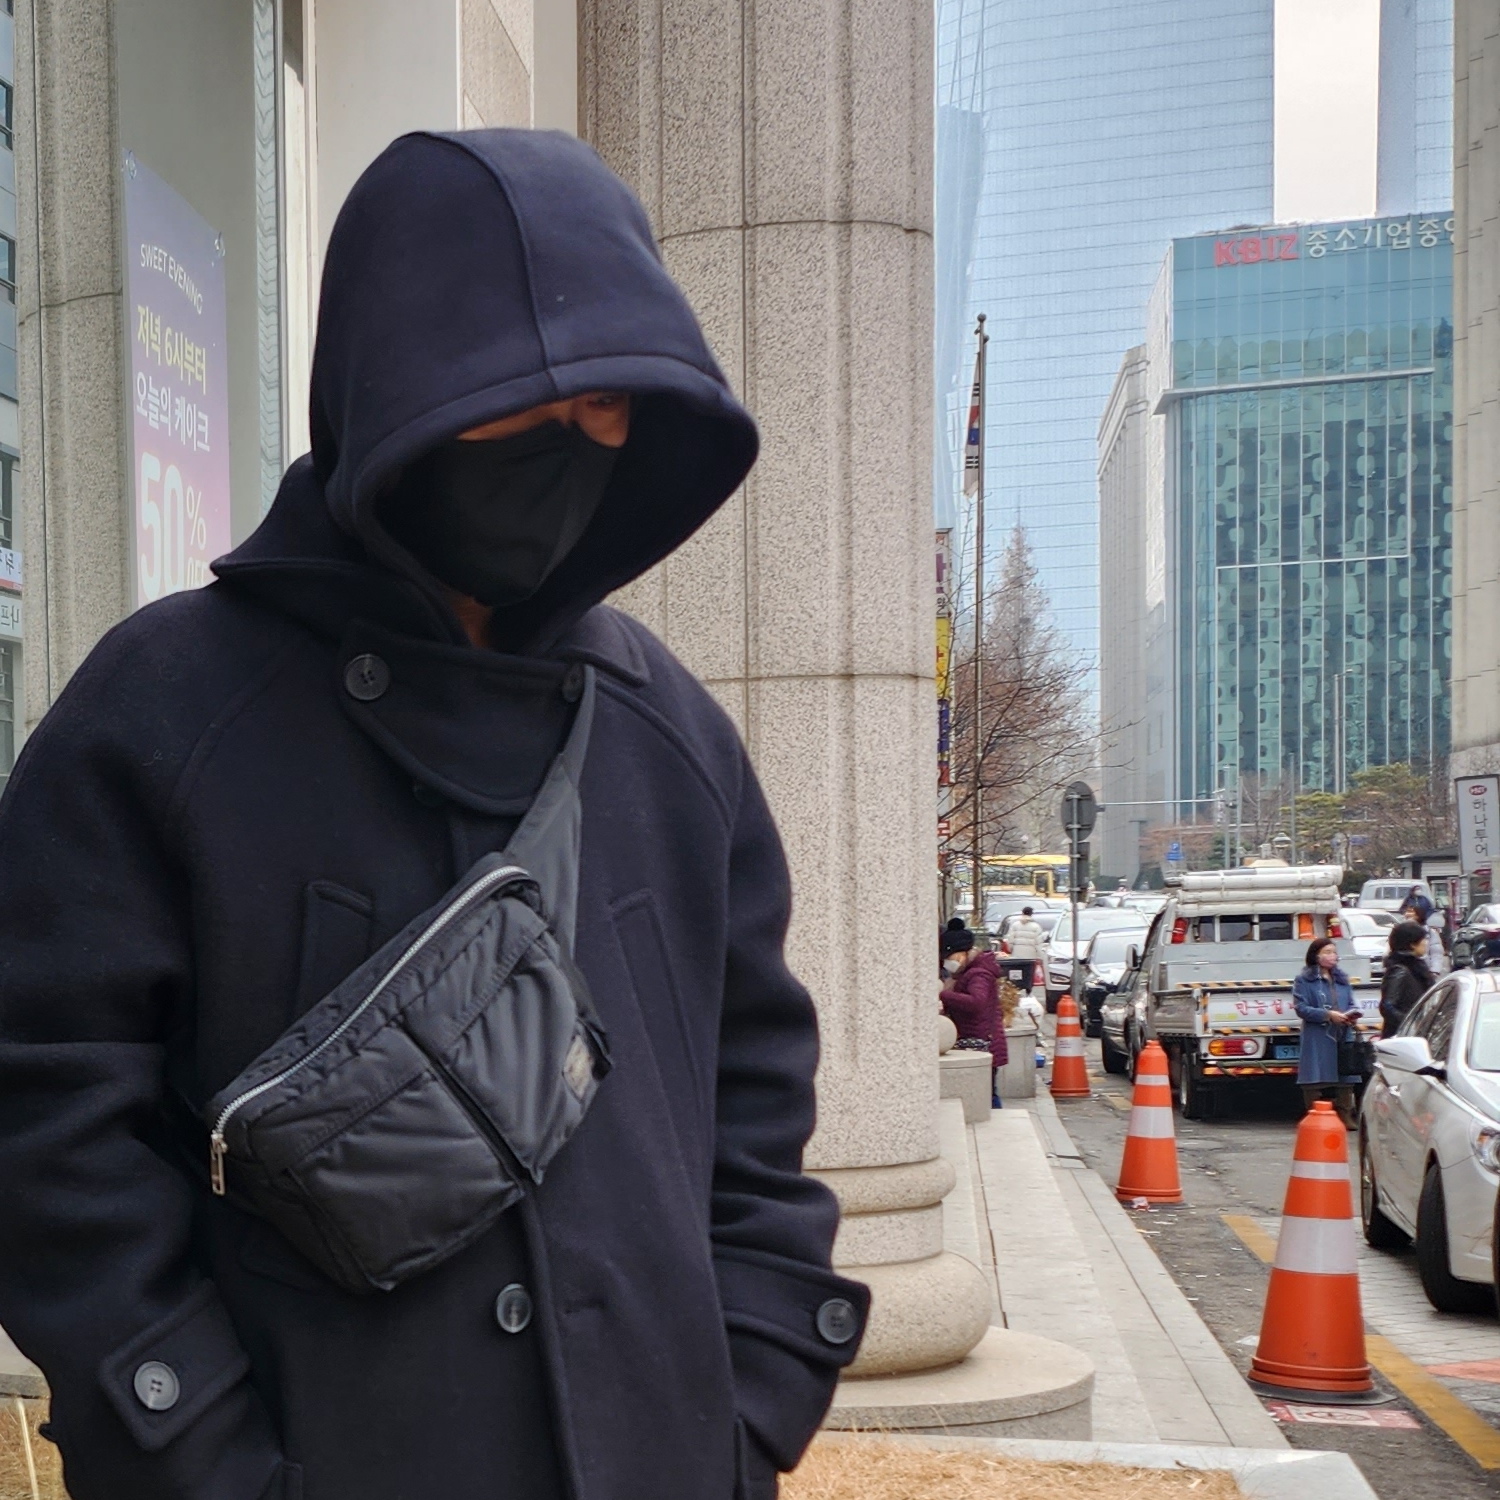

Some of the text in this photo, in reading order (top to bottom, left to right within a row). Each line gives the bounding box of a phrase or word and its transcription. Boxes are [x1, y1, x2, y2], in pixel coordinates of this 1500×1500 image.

[140, 243, 204, 315] SWEET EVENING
[1213, 235, 1299, 268] KBIZ
[137, 304, 207, 398] 저녁 6시부터
[136, 371, 211, 454] 오늘의 케이크
[1472, 797, 1489, 858] 하나투어
